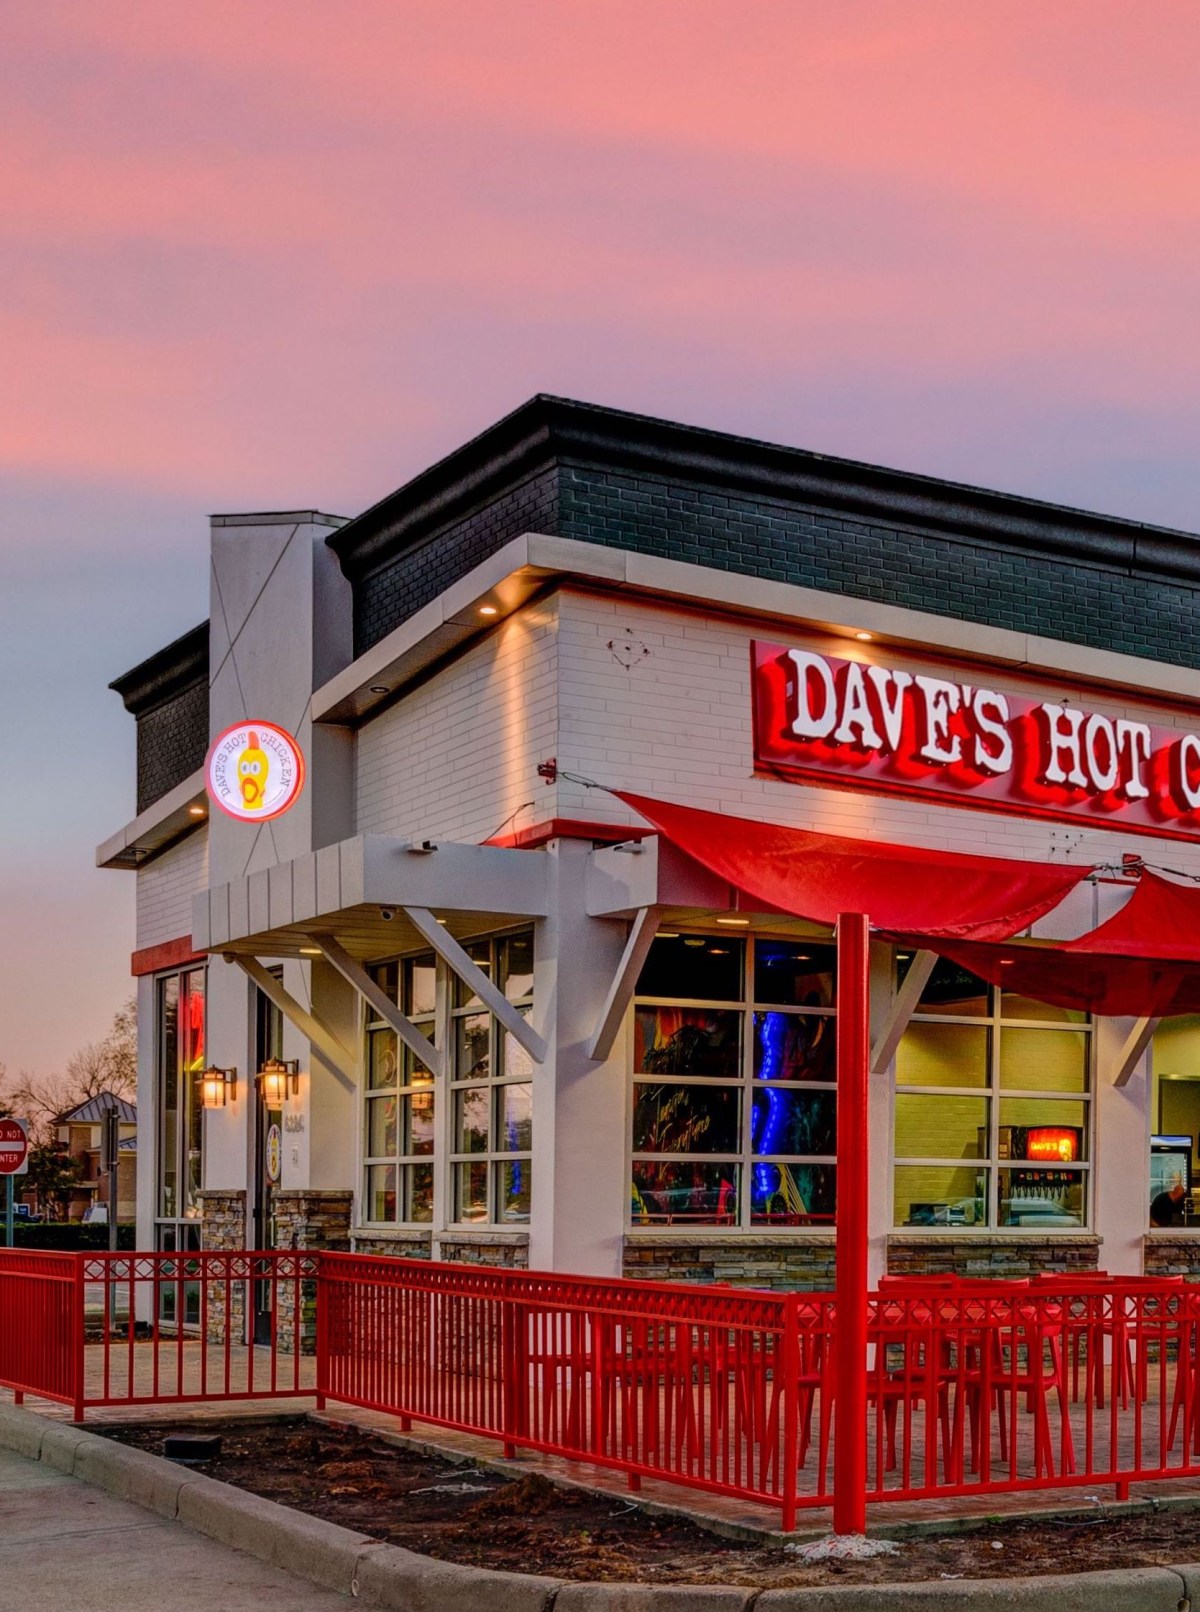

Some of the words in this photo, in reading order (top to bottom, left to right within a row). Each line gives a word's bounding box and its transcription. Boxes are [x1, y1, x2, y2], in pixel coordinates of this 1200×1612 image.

[788, 649, 1012, 773] DAVE'S
[1041, 703, 1151, 797] HOT
[215, 753, 231, 797] DAVE'S
[223, 732, 246, 753] HOT
[260, 732, 292, 787] CHICKEN
[7, 1130, 21, 1139] NOT
[0, 1153, 18, 1162] NTER
